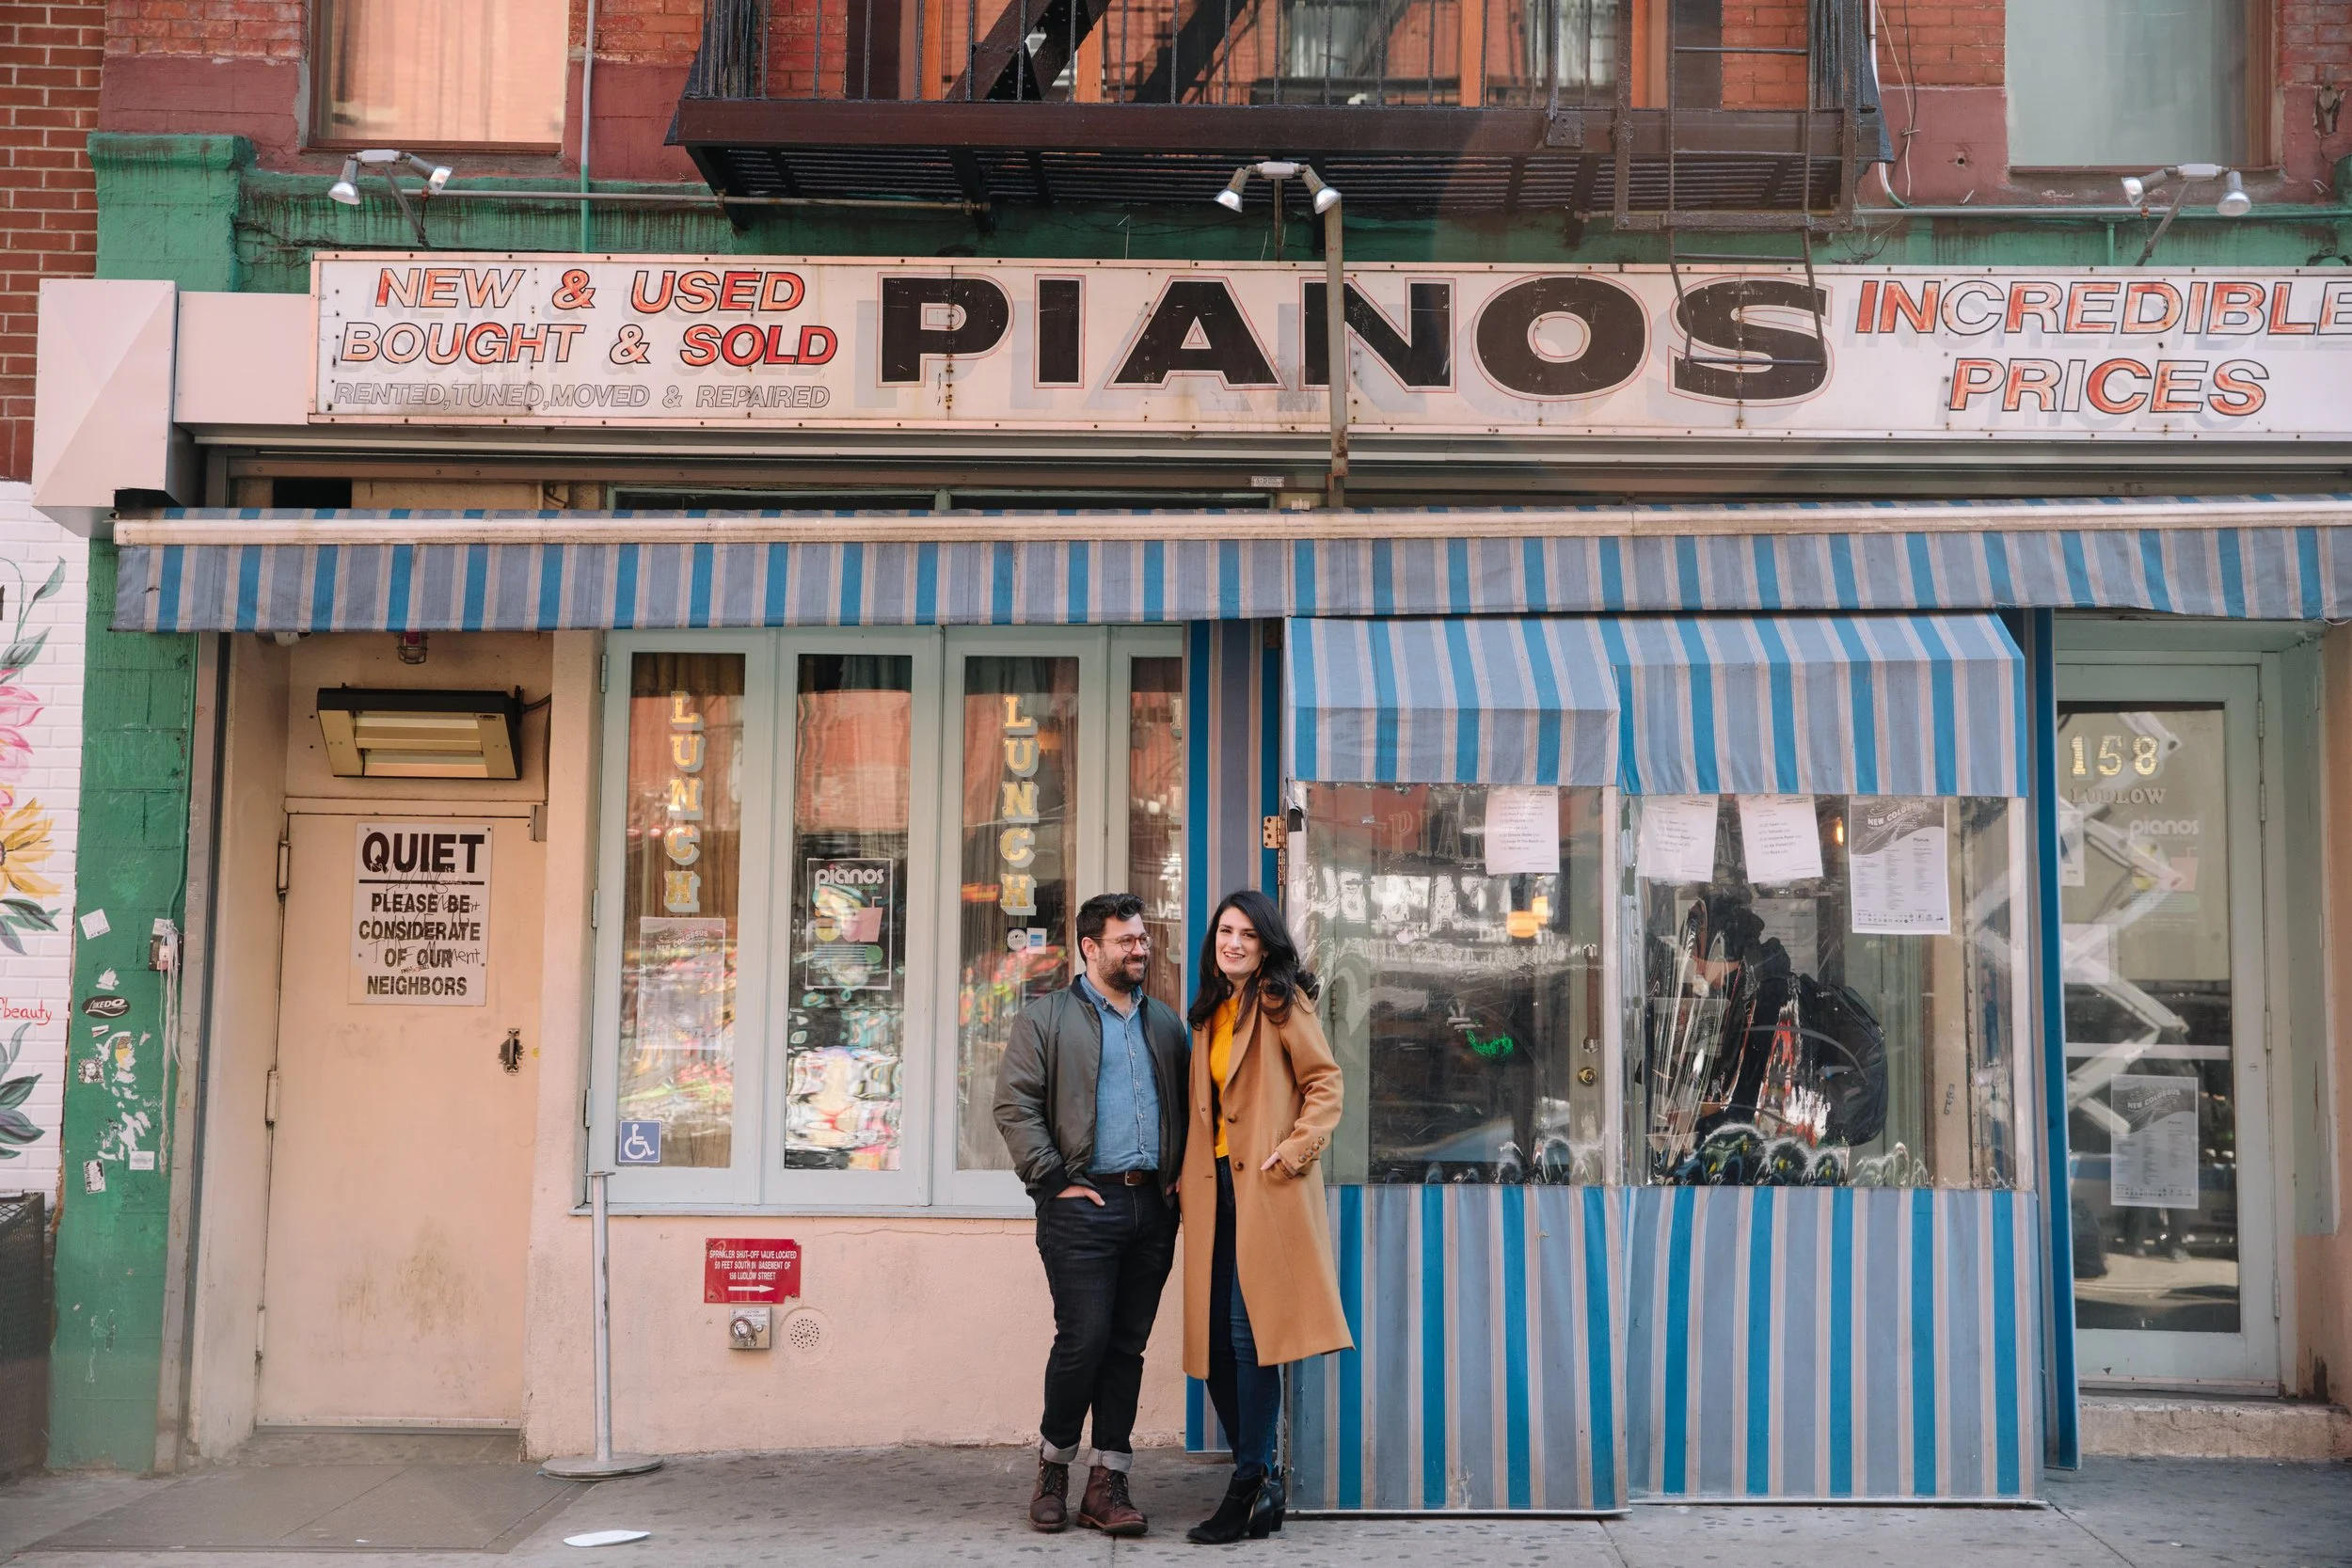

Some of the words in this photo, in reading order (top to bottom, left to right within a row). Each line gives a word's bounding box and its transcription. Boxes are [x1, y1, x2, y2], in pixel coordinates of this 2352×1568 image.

[375, 267, 527, 309] NEW
[551, 268, 596, 310] &
[630, 269, 805, 314] USED
[340, 321, 586, 366] BOUGHT
[609, 323, 652, 365] &
[679, 324, 839, 367] SOLD
[876, 271, 1835, 409] PIANOS
[661, 384, 683, 409] &
[695, 384, 832, 410] REPAIRED
[1948, 356, 2270, 417] PRICES
[2071, 735, 2160, 778] 158
[663, 690, 706, 912] LUNCH
[1000, 694, 1040, 915] LUNCH
[2071, 787, 2168, 804] LUDLOW
[1867, 816, 1884, 827] NEW
[1886, 801, 1928, 822] COLOSSUS
[2129, 815, 2200, 841] pianos
[361, 832, 485, 874] QUIET
[814, 863, 885, 890] pianos
[371, 893, 438, 912] PLEASE
[447, 895, 470, 913] BE
[358, 920, 481, 942] CONSIDERATE
[384, 947, 407, 968] OF
[416, 948, 453, 969] OUR
[367, 975, 468, 996] NEIGHBORS
[4, 997, 52, 1026] beauty
[2127, 1101, 2143, 1110] NEW
[709, 1250, 735, 1259] SPRINKLER
[736, 1250, 759, 1259] SHUT-OFF
[760, 1250, 775, 1259] VALVE
[734, 1261, 750, 1270] SOUTH
[758, 1261, 784, 1270] BASEMENT
[737, 1272, 757, 1280] LUDLOW
[757, 1272, 776, 1280] STREET
